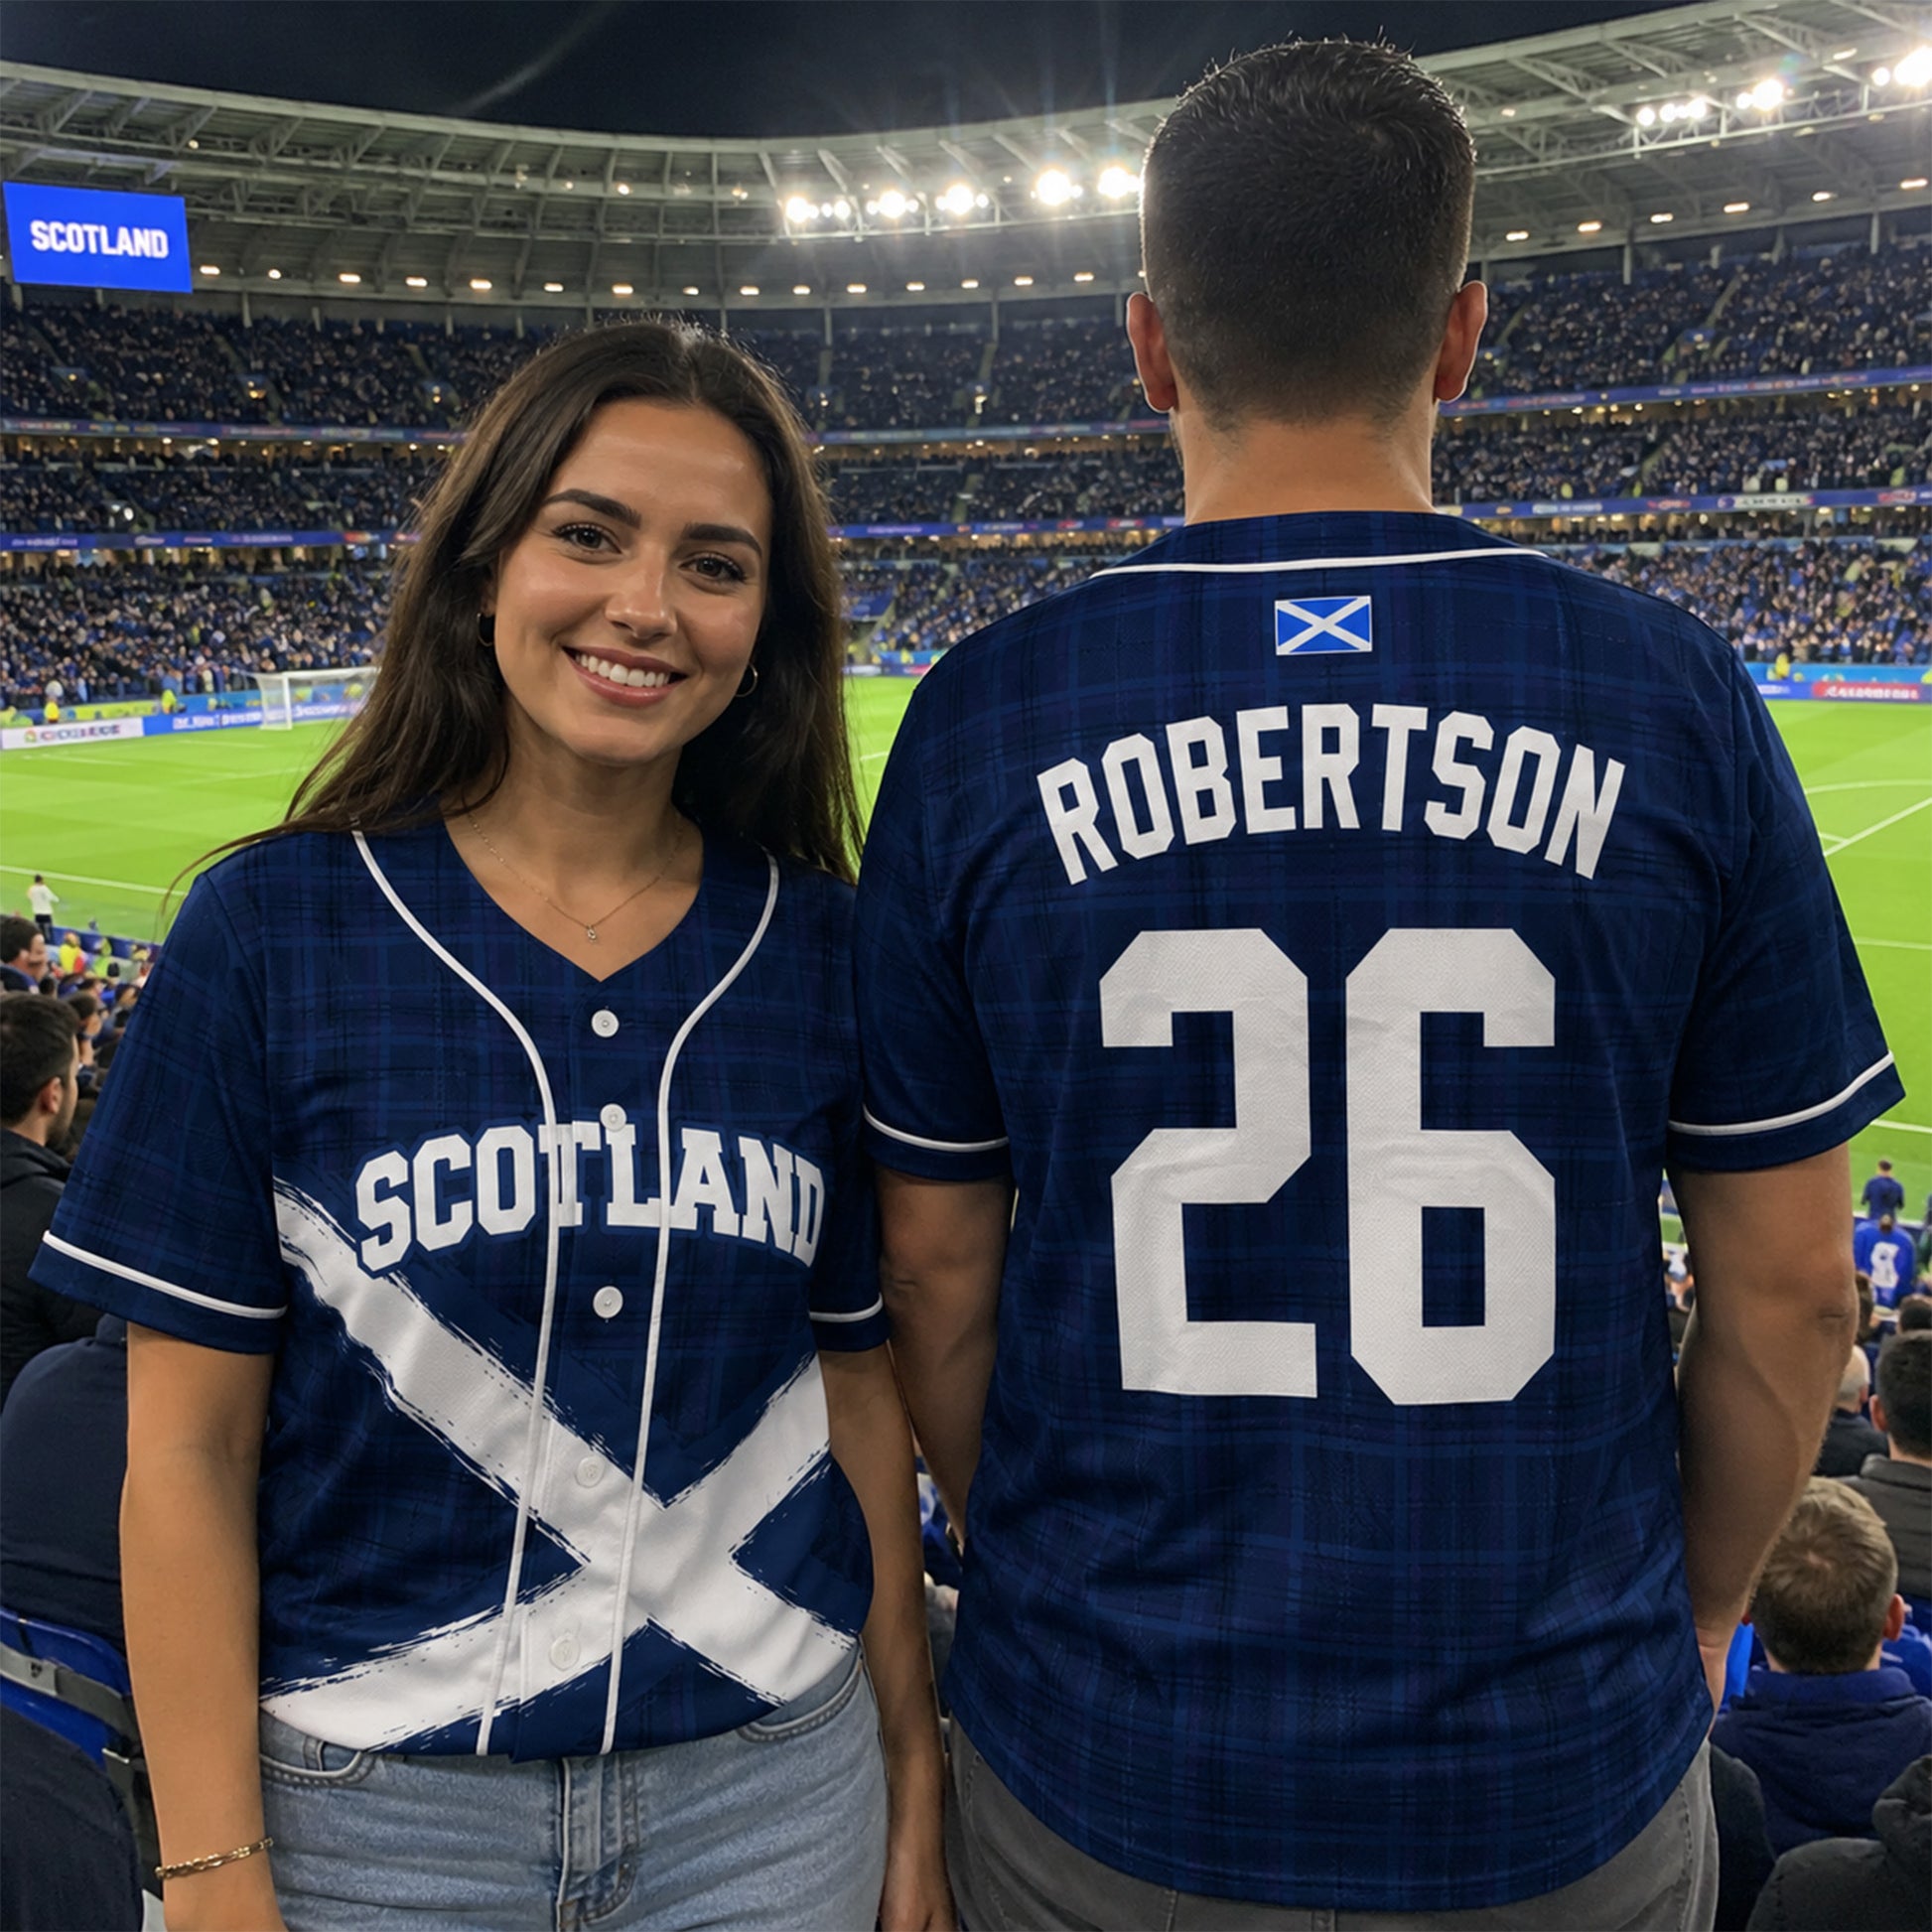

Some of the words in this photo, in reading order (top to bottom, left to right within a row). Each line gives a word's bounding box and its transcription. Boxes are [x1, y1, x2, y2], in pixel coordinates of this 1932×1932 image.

[30, 219, 169, 259] SCOTLAND
[1036, 703, 1626, 886] ROBERTSON
[355, 1119, 825, 1273] SCOTLAND
[1099, 927, 1557, 1406] 26
